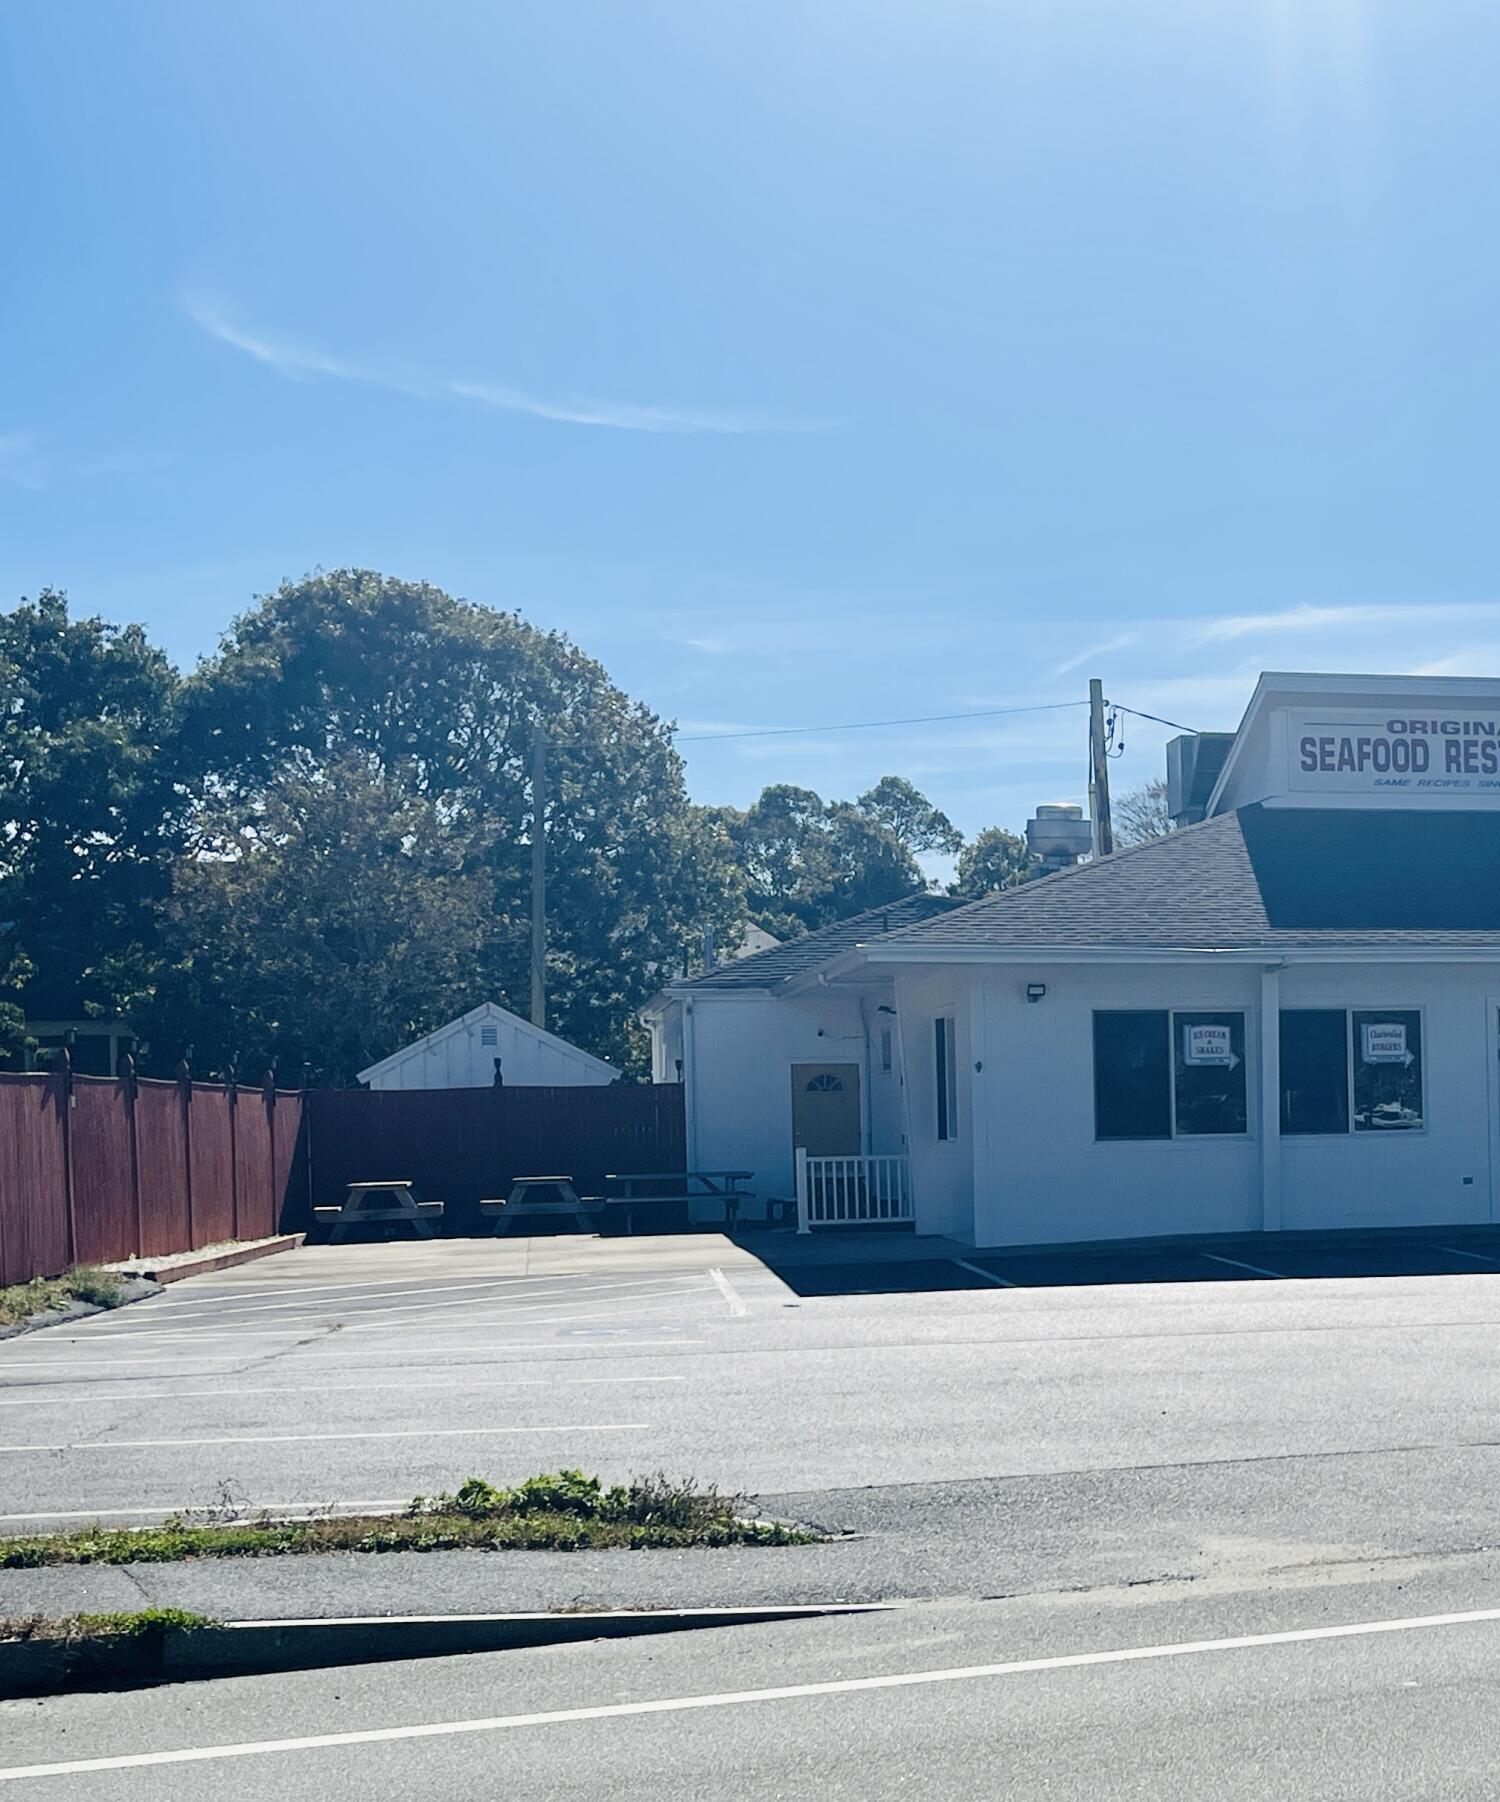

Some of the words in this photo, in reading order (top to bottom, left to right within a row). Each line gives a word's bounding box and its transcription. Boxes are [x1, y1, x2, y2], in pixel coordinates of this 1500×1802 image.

[1300, 736, 1430, 773] SEAFOOD
[1374, 778, 1410, 787] SAME
[1417, 779, 1470, 788] RECIPES
